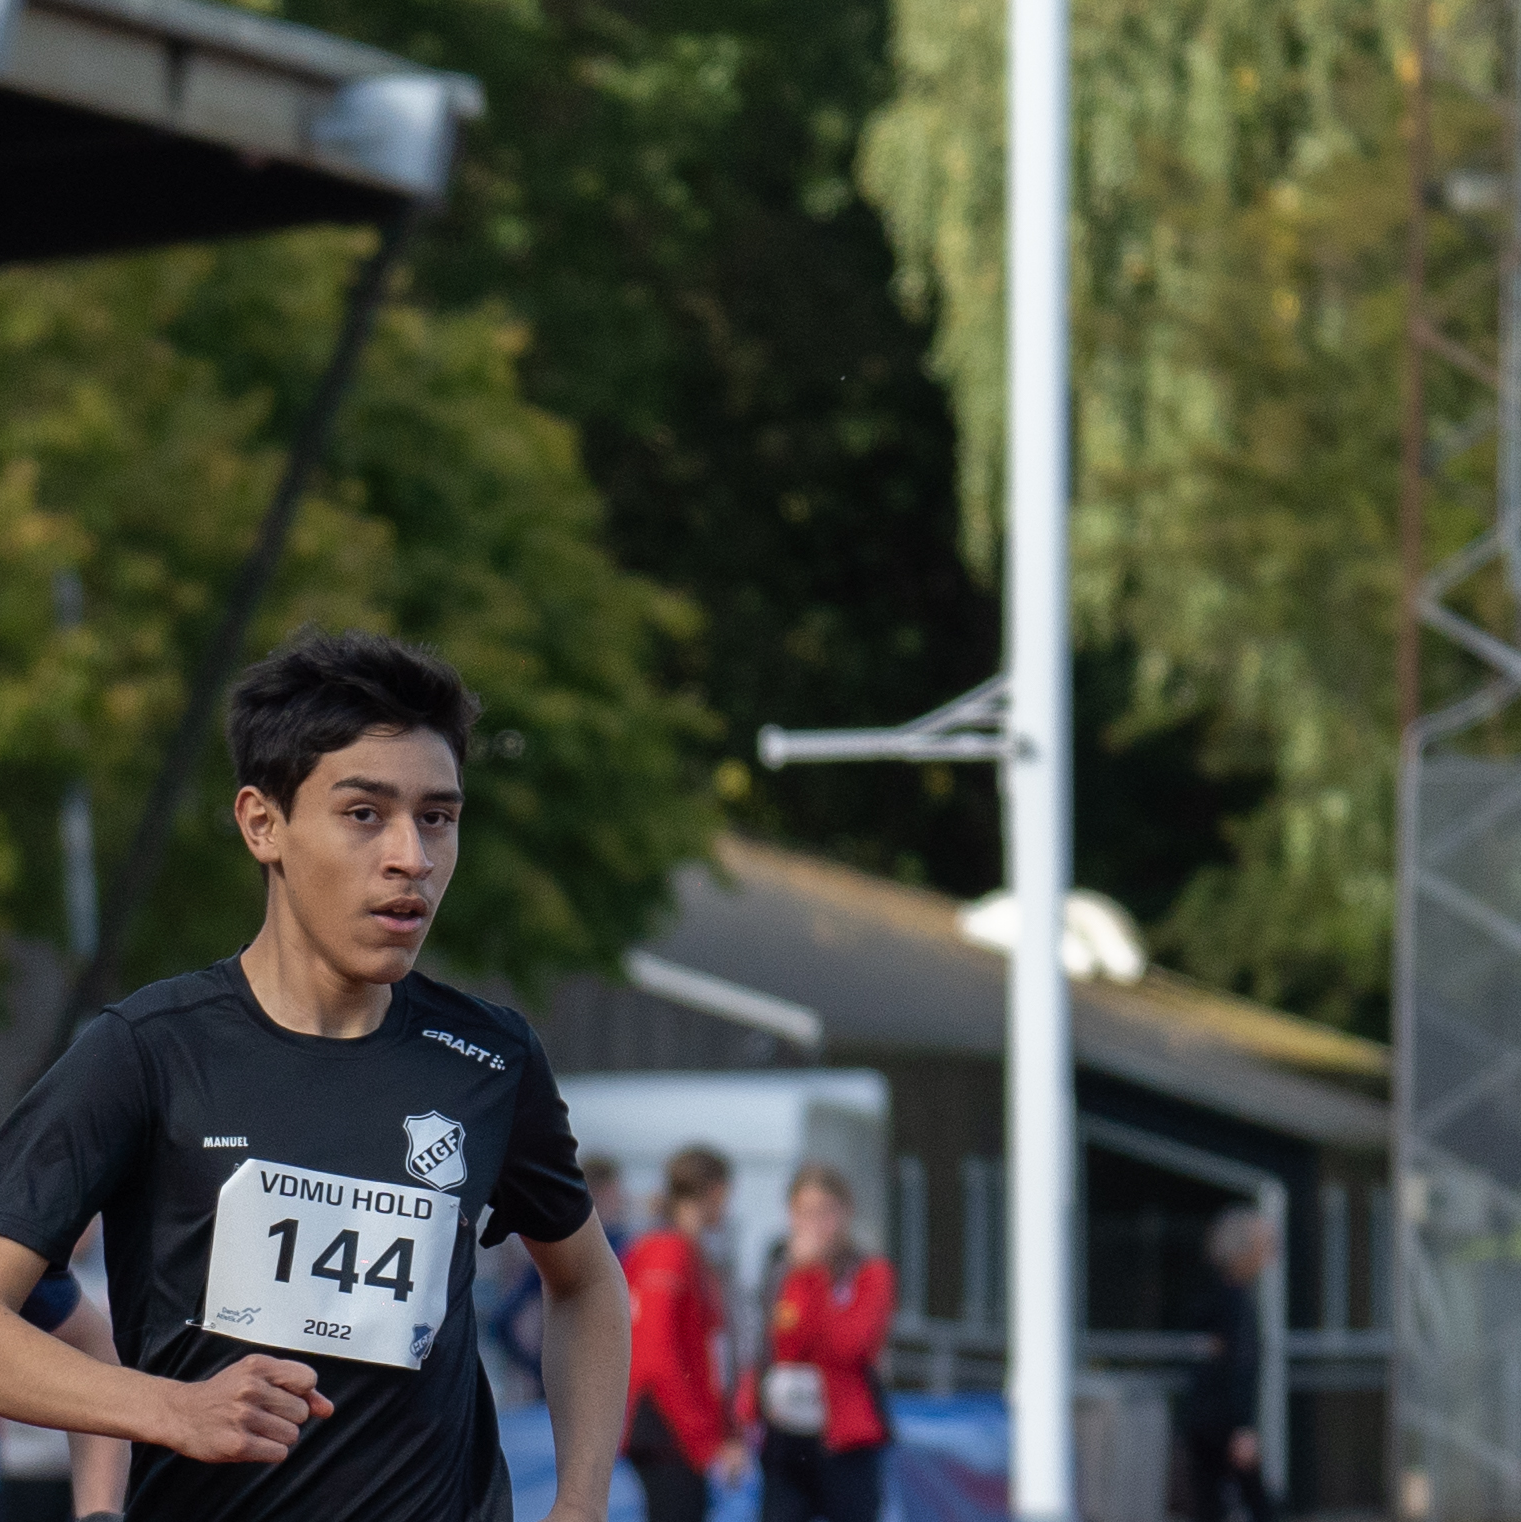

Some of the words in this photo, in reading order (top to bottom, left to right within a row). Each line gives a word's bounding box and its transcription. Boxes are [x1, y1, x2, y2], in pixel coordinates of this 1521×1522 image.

[422, 1029, 491, 1062] CRAFT
[202, 1136, 249, 1148] MANUEL
[414, 1131, 458, 1174] HGF
[260, 1170, 344, 1206] VDMU
[352, 1188, 433, 1220] HOLD
[268, 1218, 415, 1302] 144
[303, 1319, 352, 1340] 2022
